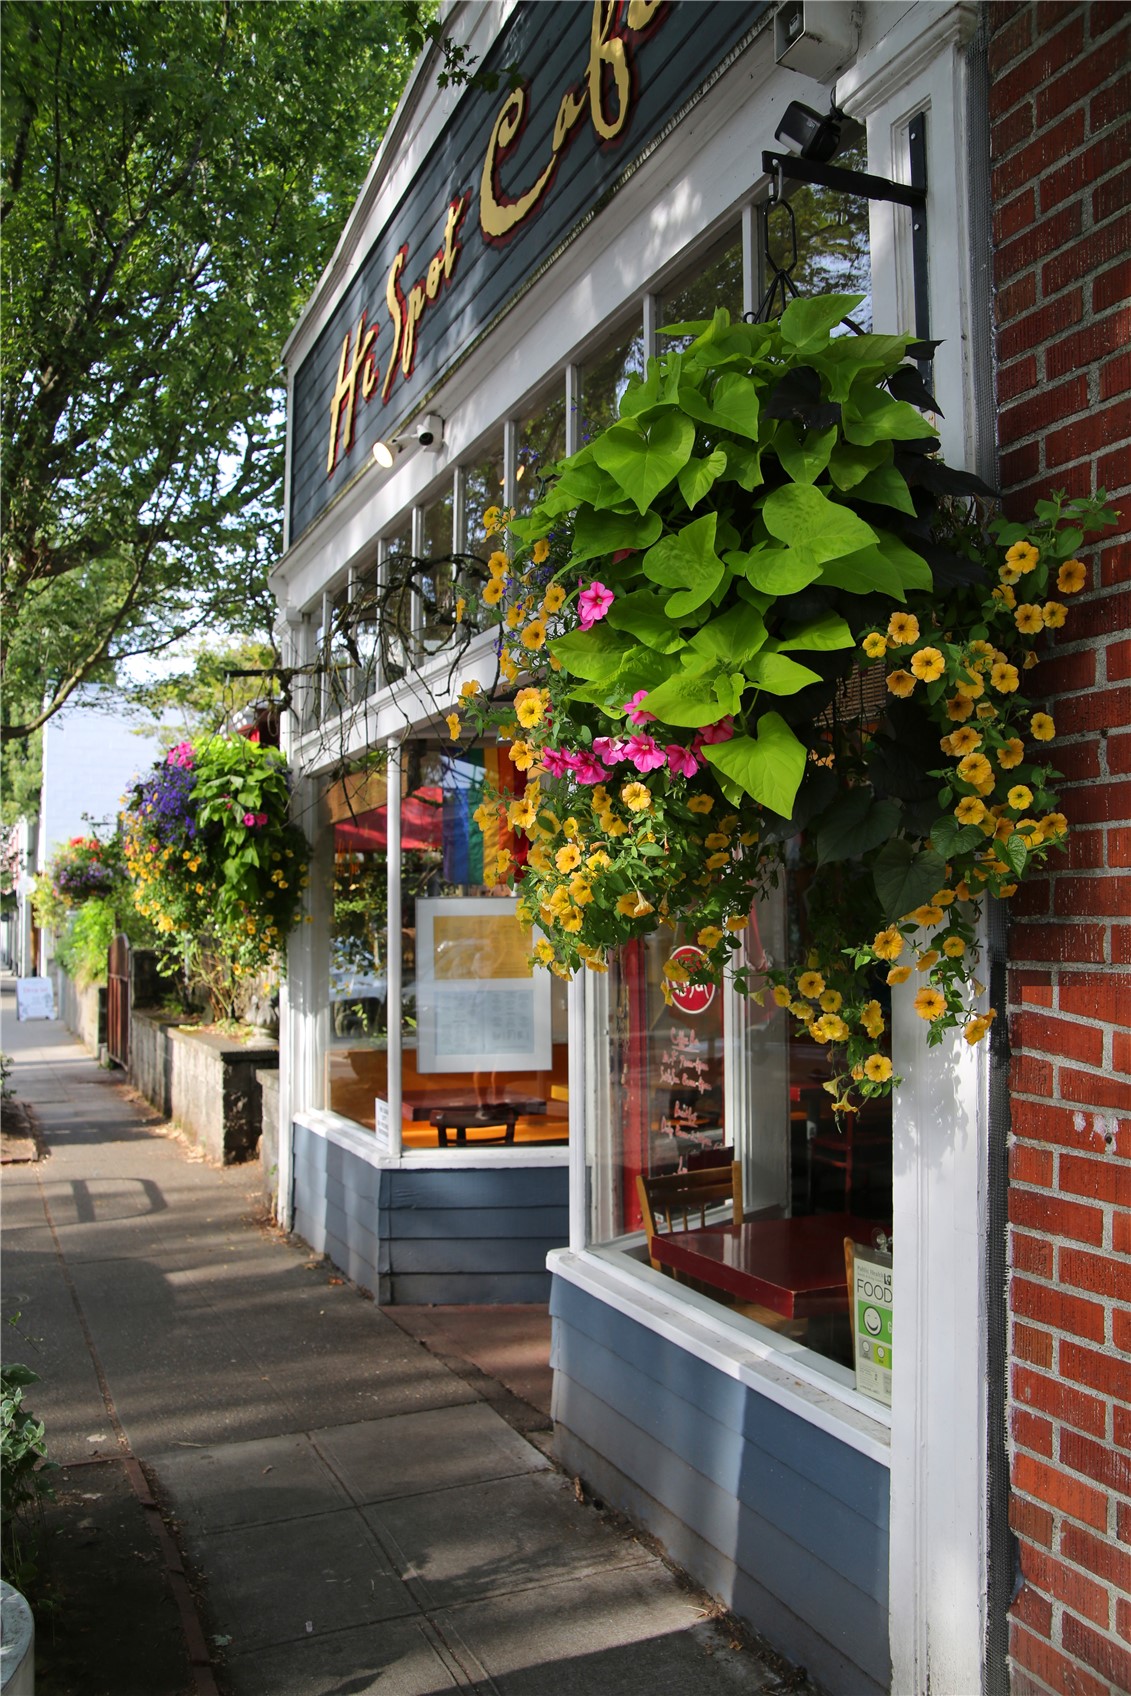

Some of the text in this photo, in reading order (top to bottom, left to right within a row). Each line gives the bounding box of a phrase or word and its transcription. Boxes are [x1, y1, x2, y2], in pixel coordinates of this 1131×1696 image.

[326, 316, 378, 475] Hi
[382, 195, 467, 402] Spot
[857, 1278, 893, 1303] FOOD
